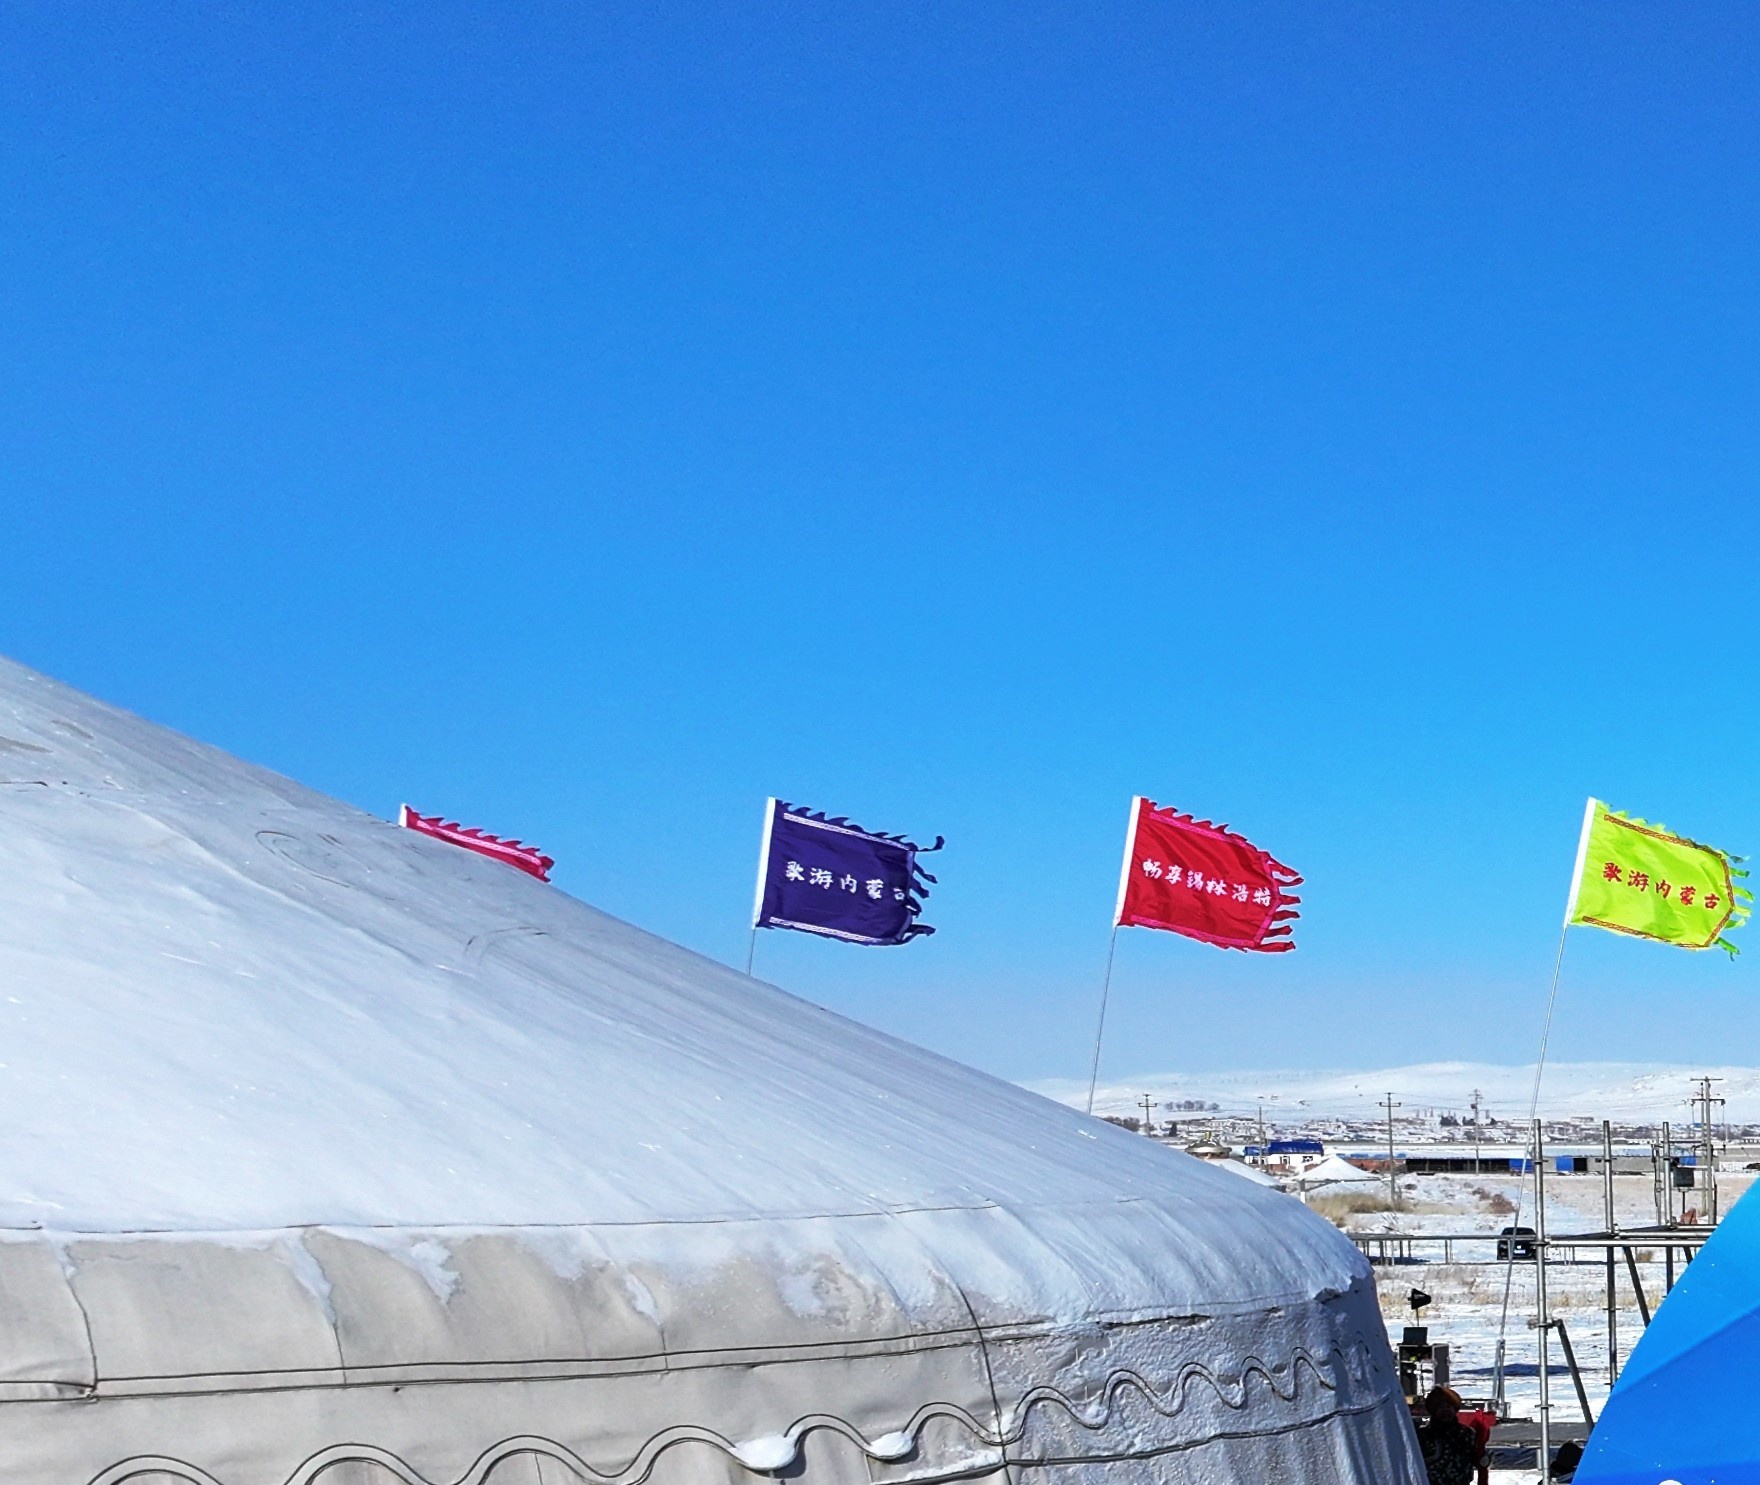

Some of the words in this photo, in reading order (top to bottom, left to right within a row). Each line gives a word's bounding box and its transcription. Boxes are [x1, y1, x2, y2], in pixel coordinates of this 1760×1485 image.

[1143, 858, 1272, 907] 畅享锡林浩特
[1603, 862, 1721, 909] 歌游内蒙古
